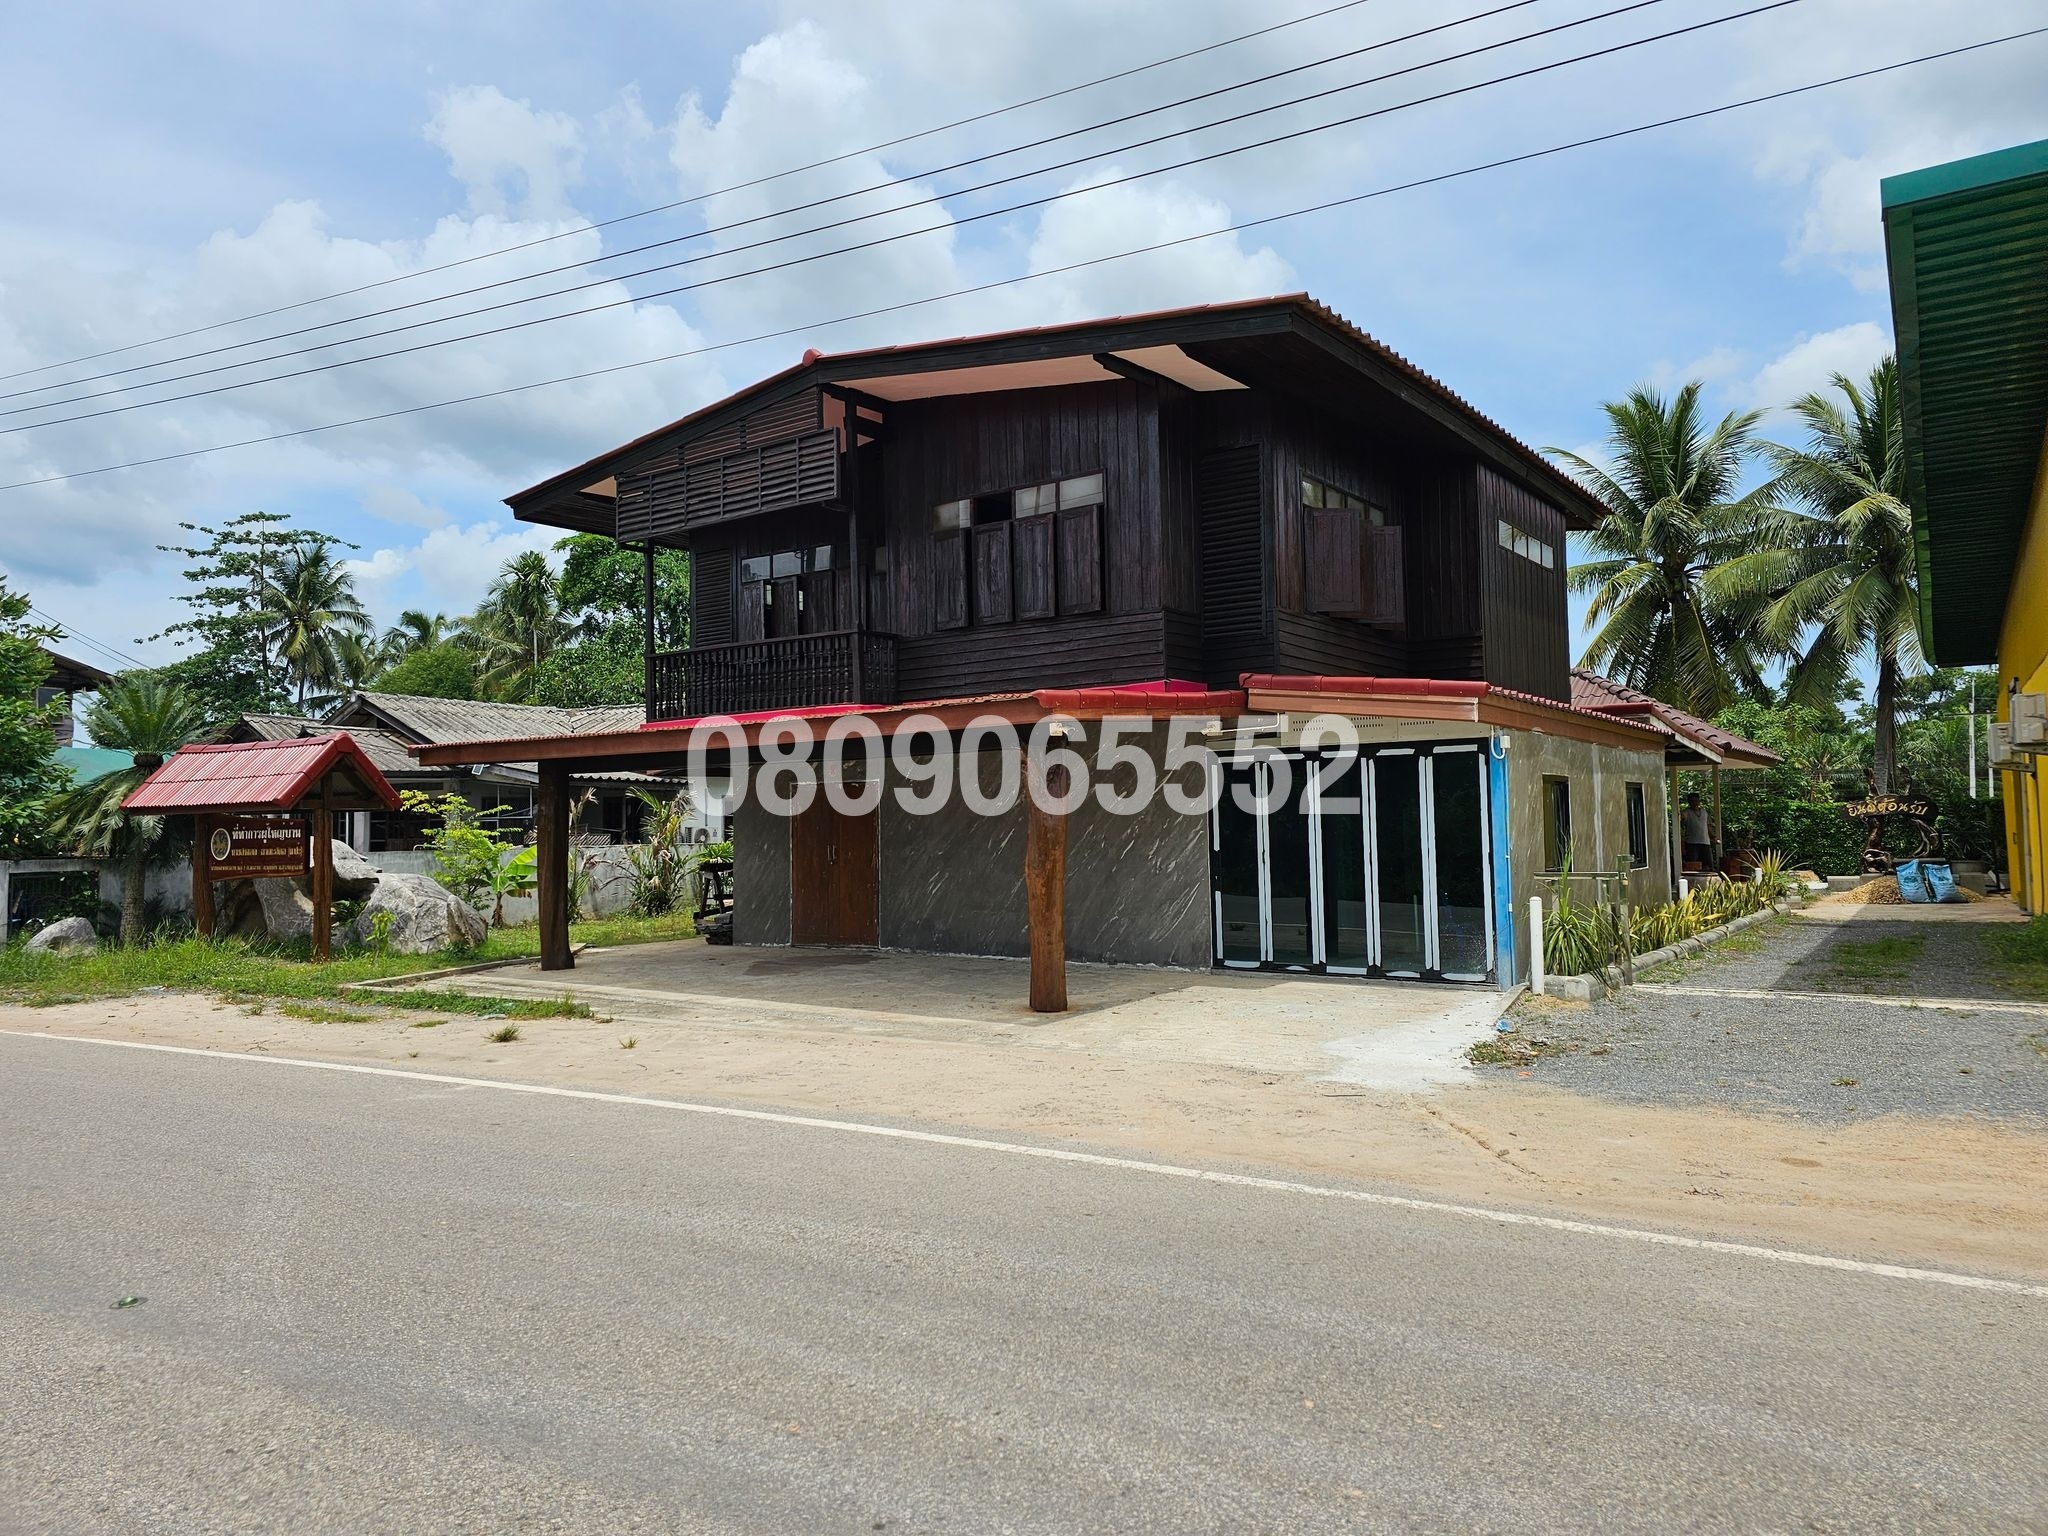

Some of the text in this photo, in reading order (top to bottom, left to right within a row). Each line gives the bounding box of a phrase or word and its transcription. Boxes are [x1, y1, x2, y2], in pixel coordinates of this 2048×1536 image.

[232, 822, 301, 844] ที่ทำการผู้ใหญ่บ้าน
